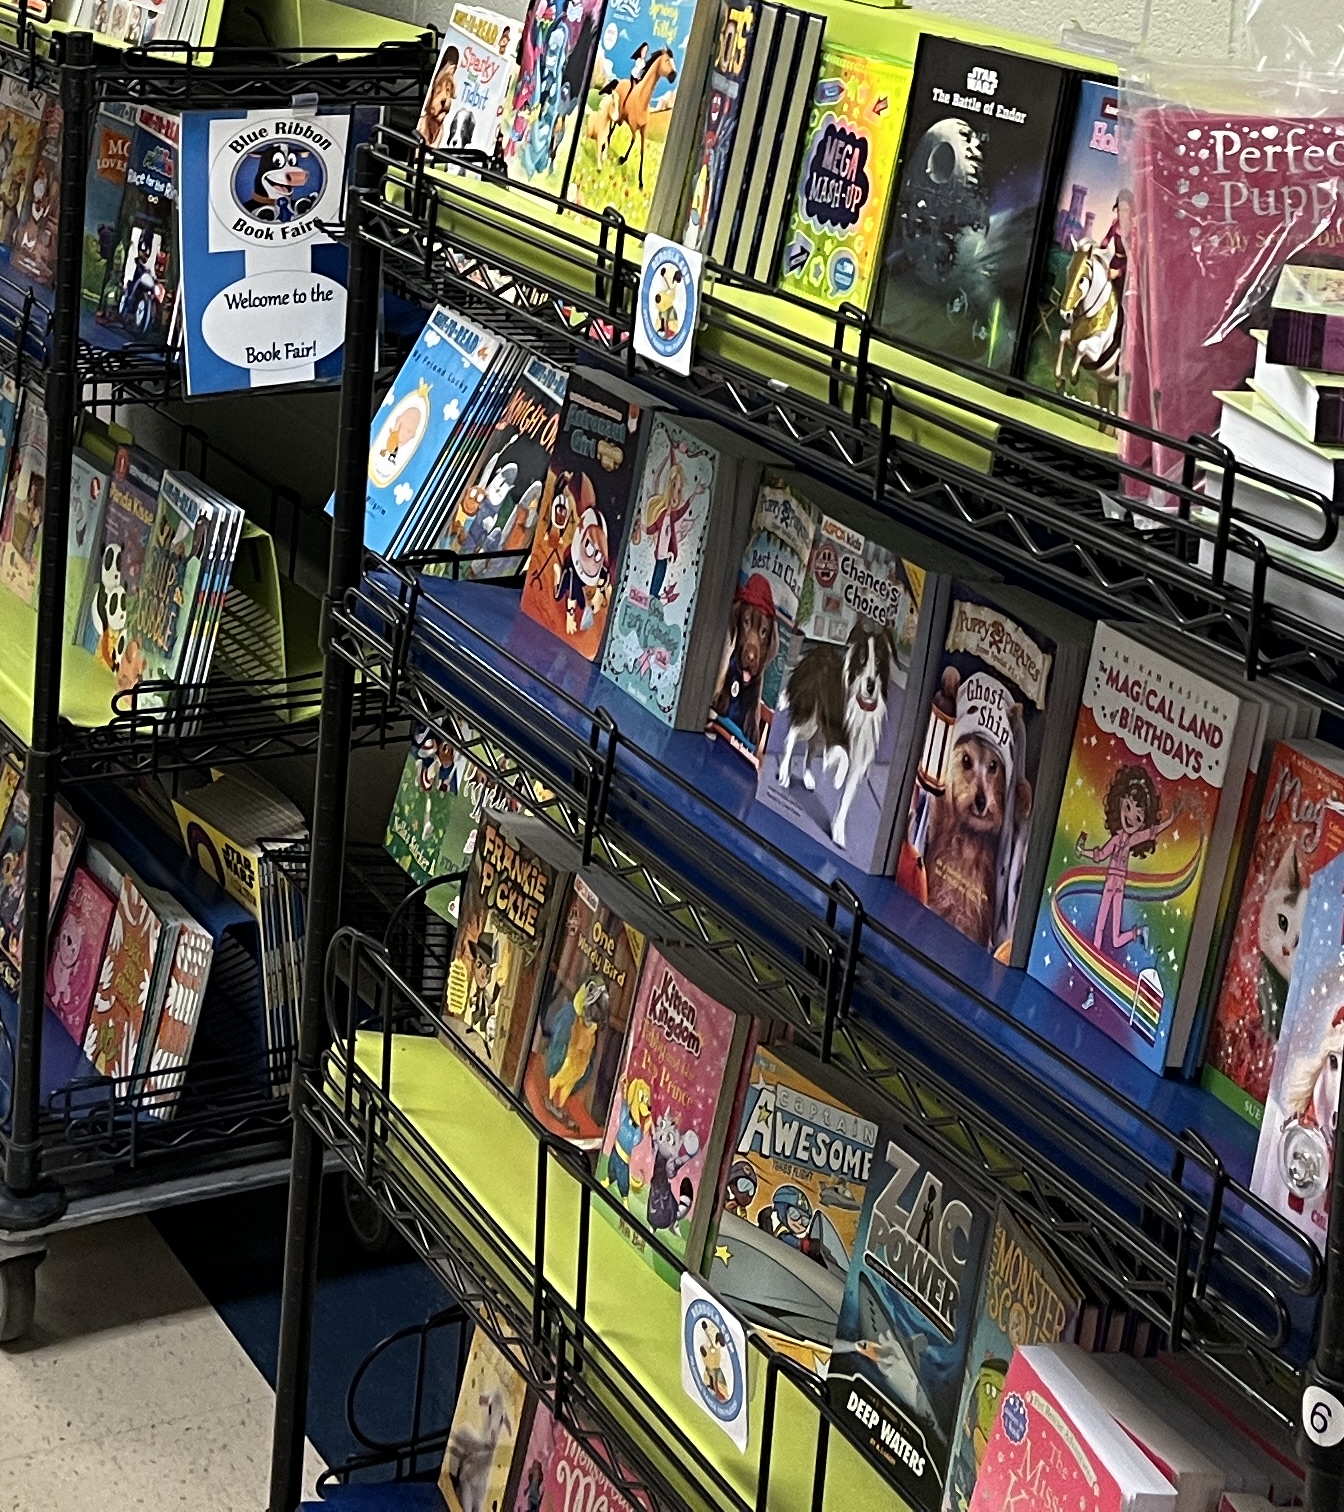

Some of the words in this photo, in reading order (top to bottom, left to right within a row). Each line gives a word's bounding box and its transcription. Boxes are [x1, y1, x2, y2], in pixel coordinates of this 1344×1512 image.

[460, 46, 500, 84] Sparky
[967, 67, 998, 83] STAR
[461, 81, 489, 111] Tidbit
[932, 88, 951, 105] The
[952, 93, 982, 113] Battle
[983, 101, 995, 115] of
[967, 77, 998, 95] WARS
[228, 126, 268, 155] Blue
[275, 121, 333, 152] Ribbon
[822, 135, 861, 181] MEGA
[809, 172, 862, 213] MASH-UP
[232, 217, 274, 240] Book
[224, 290, 290, 310] Welcome
[293, 287, 307, 304] to
[310, 283, 334, 303] the
[245, 342, 281, 364] Book
[284, 340, 317, 359] Fair!
[496, 387, 548, 440] KNIGHT
[110, 481, 133, 512] Panda
[133, 499, 155, 527] Kisse
[751, 549, 771, 569] Best
[771, 555, 783, 578] in
[841, 555, 899, 602] Chance's
[844, 584, 887, 624] Choice
[967, 678, 1004, 711] Ghost
[1106, 665, 1174, 724] MAGICAL
[1177, 706, 1224, 750] LAND
[977, 705, 1010, 748] Ship
[1119, 706, 1204, 774] BIRTHDAYS
[222, 843, 252, 876] STAR
[223, 854, 256, 890] WARS
[592, 921, 615, 957] One
[577, 934, 602, 974] Wordy
[603, 955, 626, 988] Bird
[661, 968, 698, 1028] Kitten
[648, 987, 702, 1056] Kingdom
[659, 1066, 694, 1107] Prince
[1244, 1100, 1262, 1120] SUE
[738, 1088, 874, 1182] AWESOME
[874, 1140, 974, 1272] ZAC
[866, 1208, 960, 1332] POWER
[846, 1390, 880, 1430] DEEP
[1310, 1401, 1333, 1434] 6
[880, 1419, 926, 1477] WATERS
